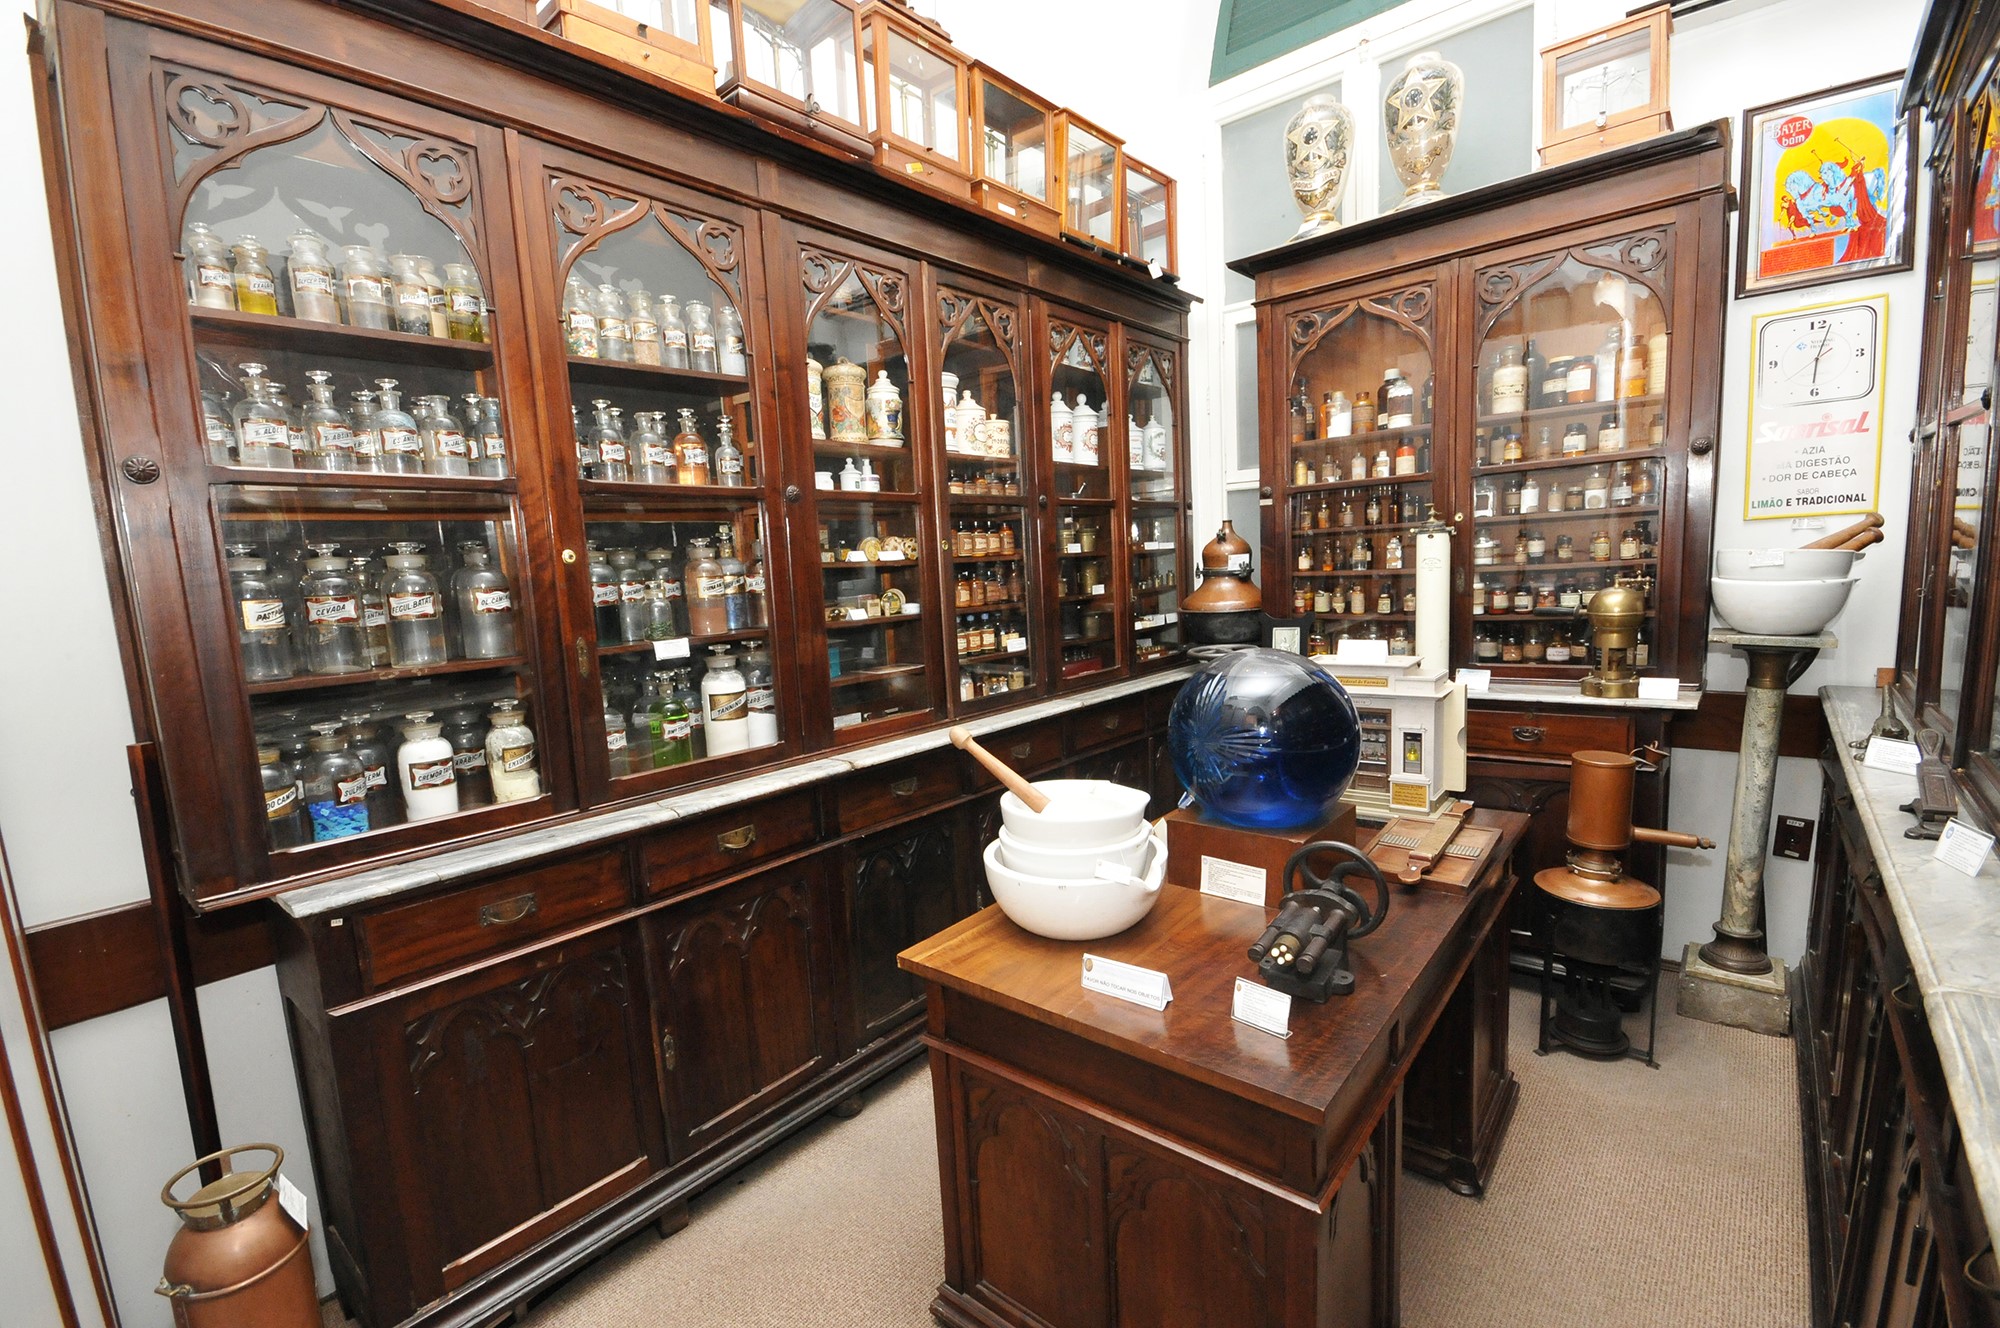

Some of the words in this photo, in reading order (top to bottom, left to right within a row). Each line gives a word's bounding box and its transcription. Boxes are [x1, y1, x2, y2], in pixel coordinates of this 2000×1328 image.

[1773, 120, 1812, 138] BAYER
[1810, 320, 1827, 330] 12
[1855, 348, 1865, 357] 3
[1769, 360, 1778, 369] 9
[1810, 388, 1820, 397] 6
[1801, 446, 1826, 455] AZIA
[1795, 455, 1851, 468] DIGESTÃO
[1769, 474, 1791, 482] DOR
[1794, 472, 1808, 480] DE
[1812, 468, 1857, 479] CABEÇA
[1752, 497, 1783, 509] LIMÃO
[1786, 498, 1792, 506] E
[1796, 493, 1867, 505] TRADICIONAL
[315, 604, 346, 616] CEVADA
[717, 698, 743, 715] TANNINO
[1100, 979, 1110, 987] NÃO
[1110, 982, 1127, 992] TOCAR
[1138, 991, 1161, 1001] OBJETOS
